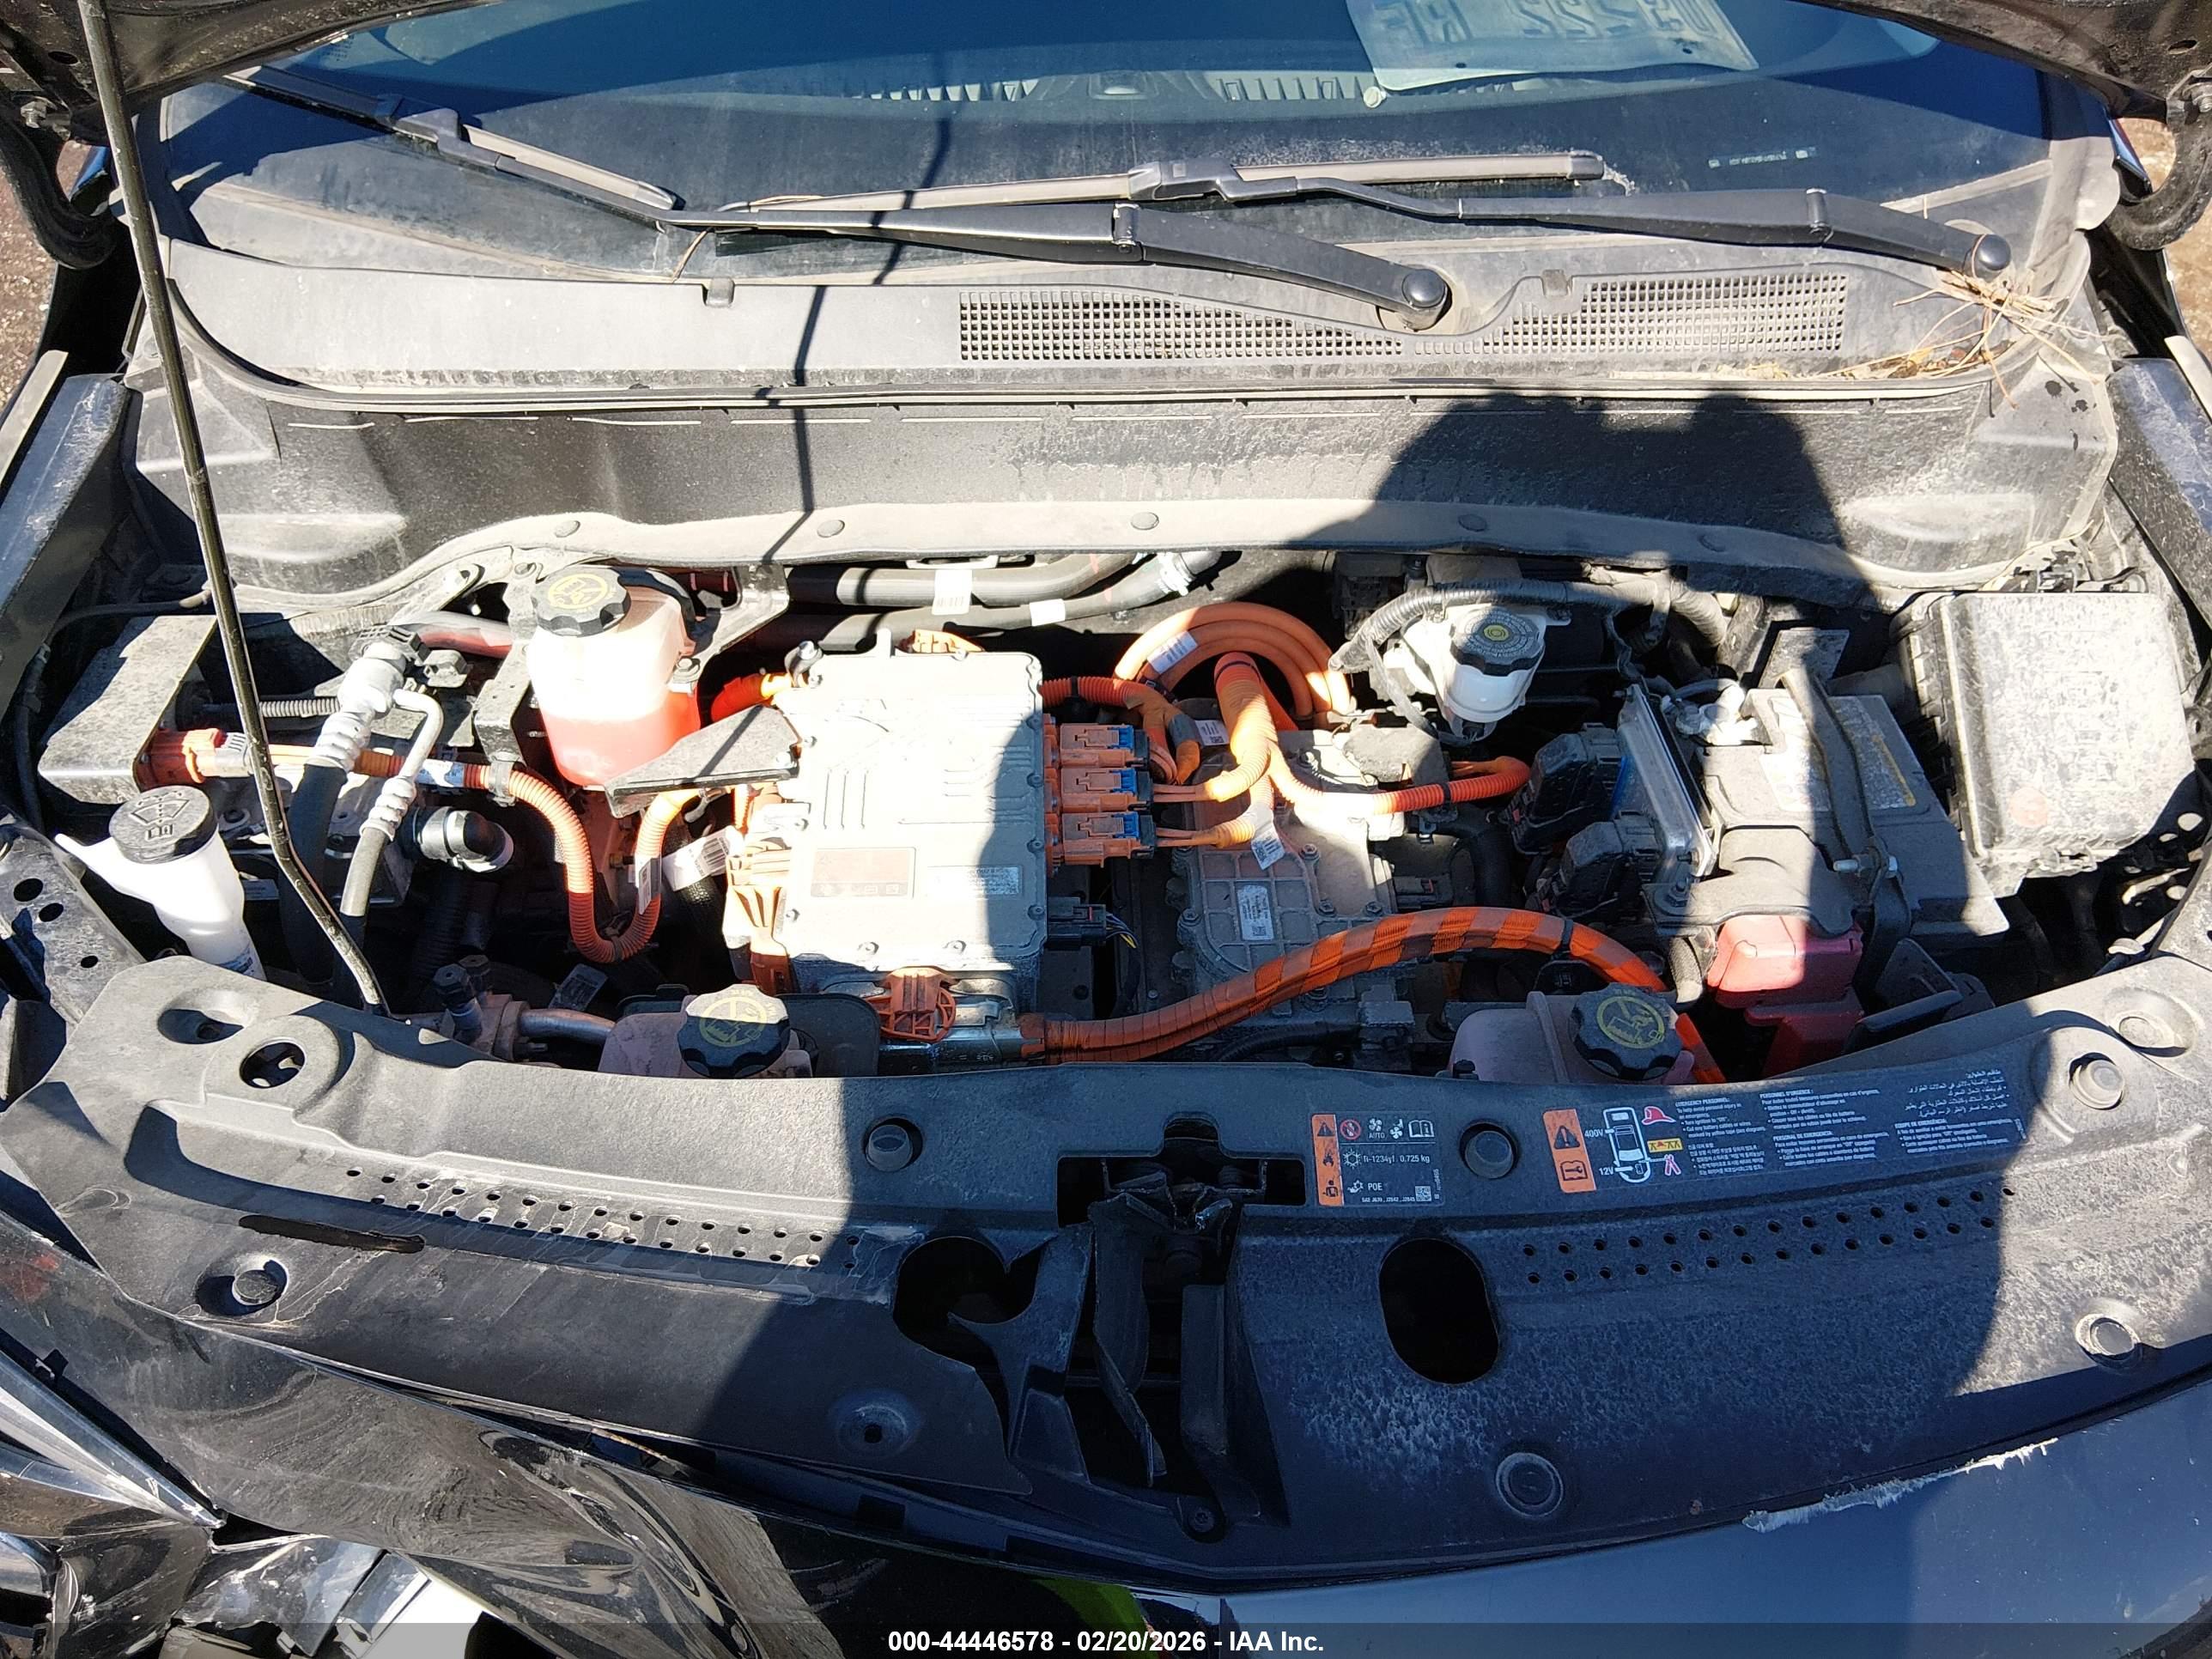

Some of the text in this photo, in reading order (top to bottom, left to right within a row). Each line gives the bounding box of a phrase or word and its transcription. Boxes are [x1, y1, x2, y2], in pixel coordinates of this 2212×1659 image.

[1584, 1129, 1603, 1138] 400V
[1420, 1154, 1430, 1164] kg
[1368, 1182, 1382, 1191] POE
